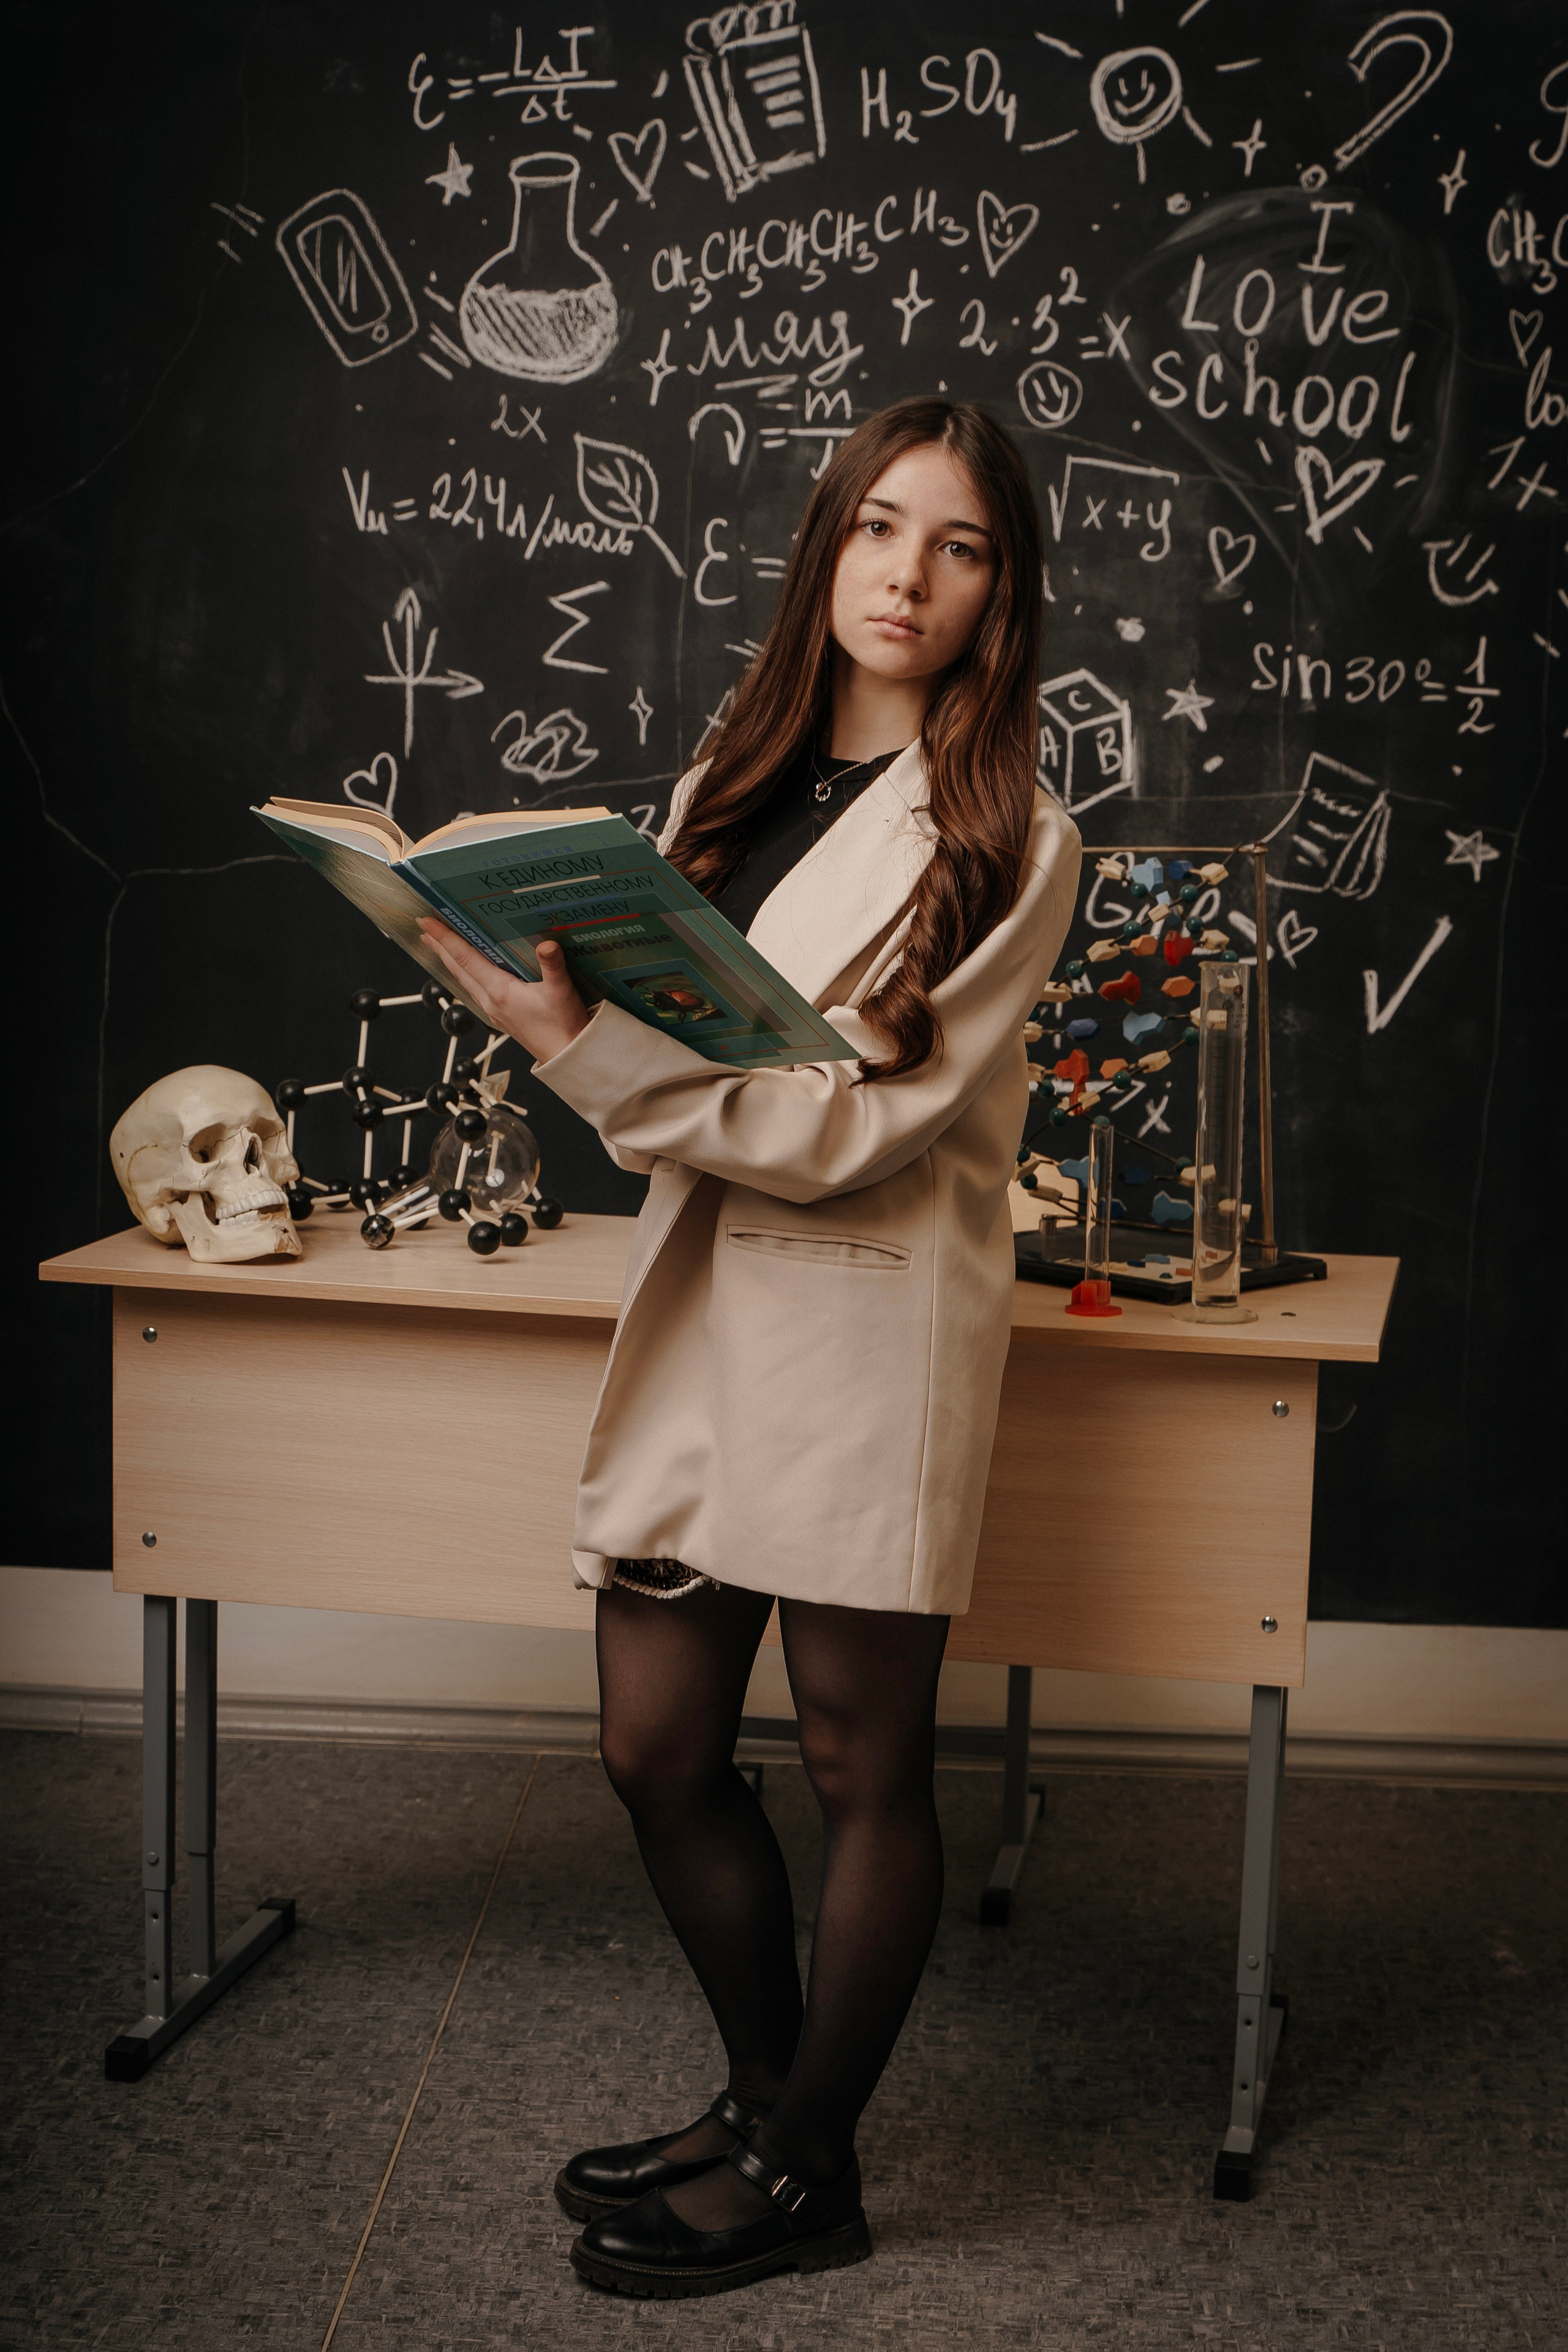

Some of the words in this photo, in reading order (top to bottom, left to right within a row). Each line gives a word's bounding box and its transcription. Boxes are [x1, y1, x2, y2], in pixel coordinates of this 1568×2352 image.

[861, 48, 1017, 143] H2SO4
[1297, 201, 1354, 273] I
[478, 874, 502, 891] К
[496, 854, 605, 888] ЕДИНОМУ
[482, 845, 575, 869] ГОТОВИМСЯ
[478, 874, 655, 916] ГОСУДАРСТВЕННОМУ
[538, 899, 631, 926] ЭКЗАМЕНУ
[440, 907, 505, 964] БИОЛОГИЯ
[565, 932, 674, 957] Животные
[571, 924, 646, 943] БИОЛОГИЯ
